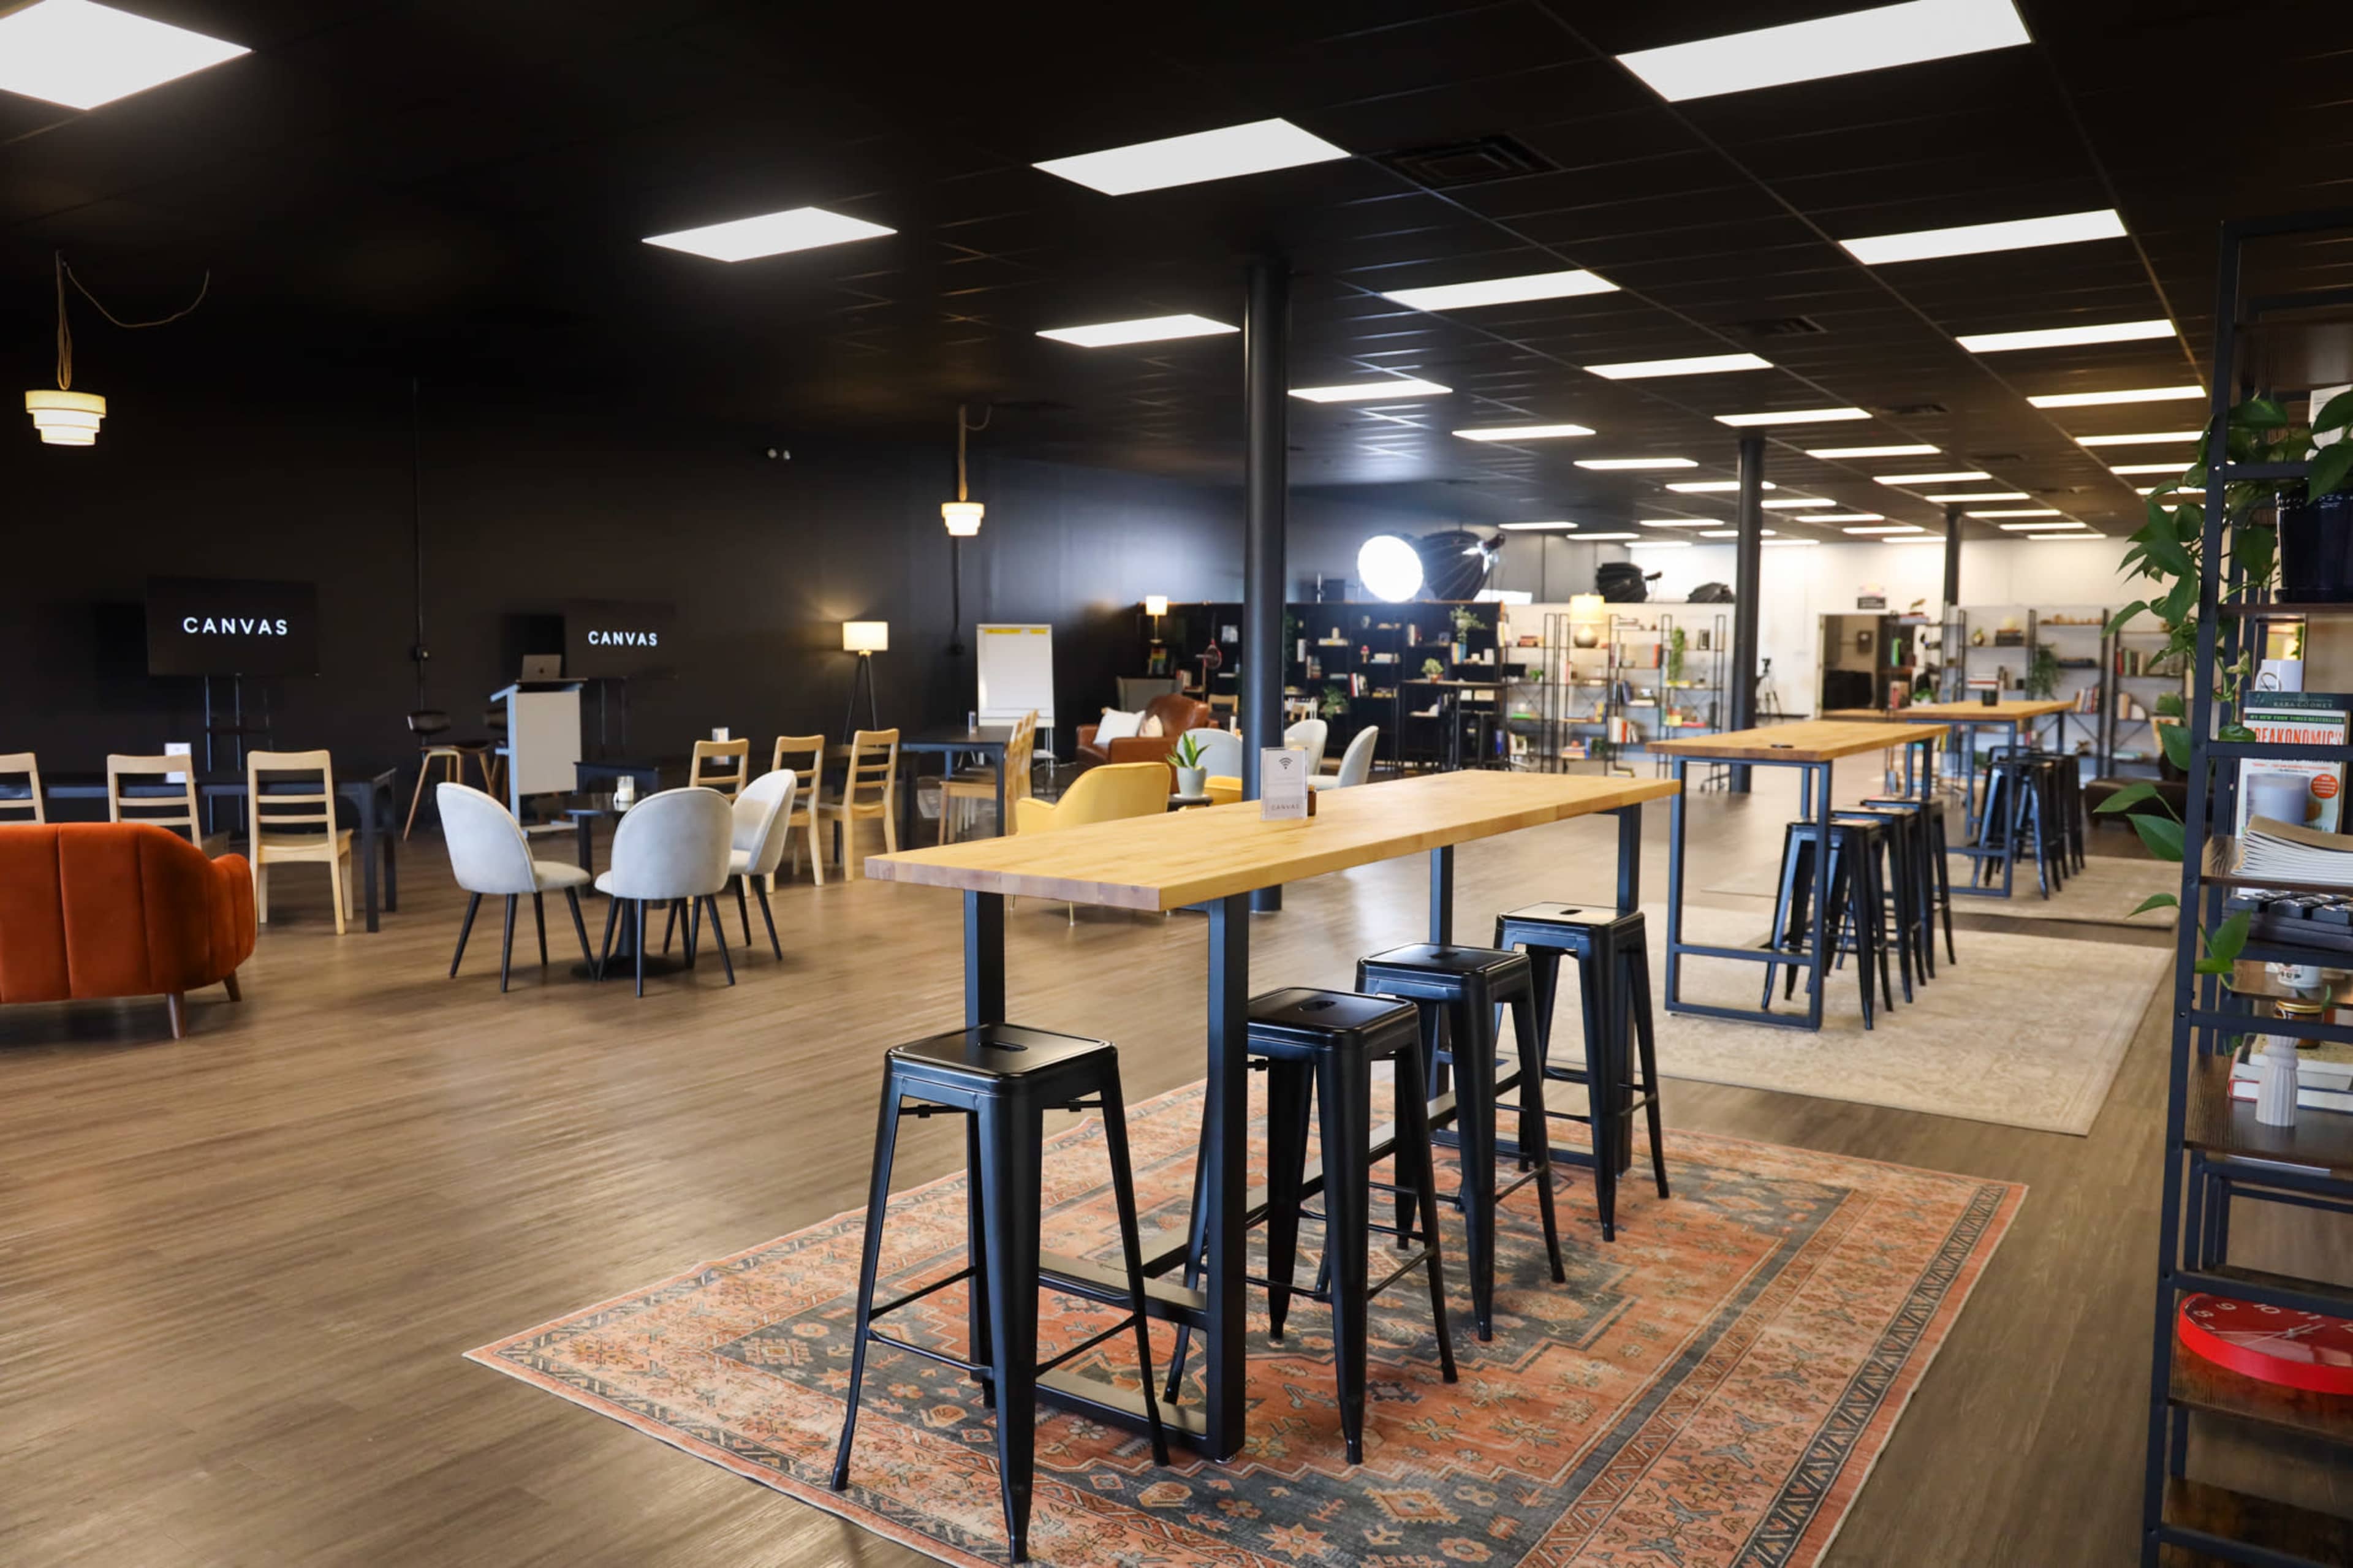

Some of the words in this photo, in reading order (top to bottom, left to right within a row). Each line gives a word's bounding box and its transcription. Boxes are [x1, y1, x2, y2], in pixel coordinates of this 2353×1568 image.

[183, 616, 288, 635] CANVAS
[588, 630, 657, 646] CANVAS
[2253, 1304, 2281, 1314] 10
